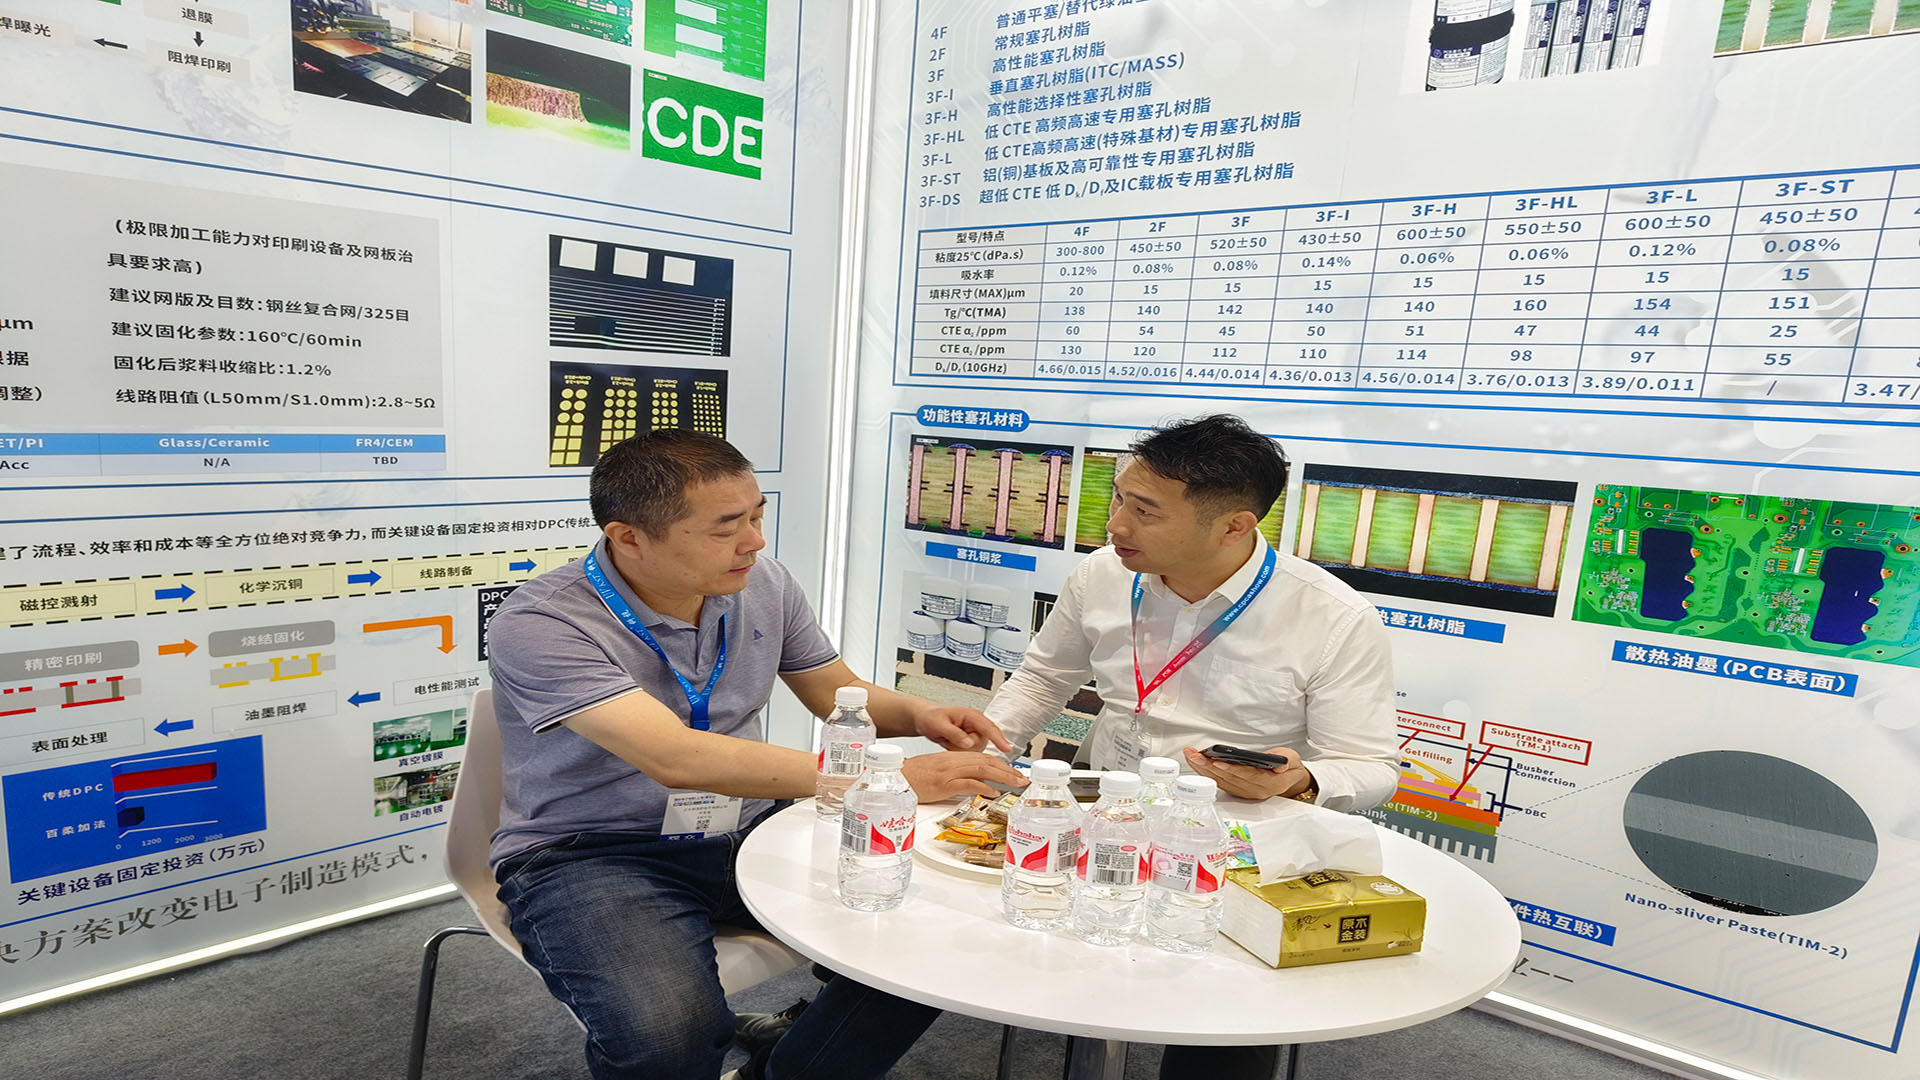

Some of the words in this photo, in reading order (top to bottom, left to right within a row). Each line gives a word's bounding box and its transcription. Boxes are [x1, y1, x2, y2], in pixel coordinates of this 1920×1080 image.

[181, 7, 213, 25] 退膜
[930, 26, 948, 40] 4F
[995, 20, 1091, 51] 常规塞孔树脂
[167, 50, 232, 74] 阻焊印刷
[929, 48, 946, 62] 2F
[992, 41, 1106, 74] 高性能塞孔树脂
[928, 69, 945, 83] 3F
[989, 51, 1185, 96] 垂直塞孔树脂(ITC/MASS)
[926, 89, 954, 104] 3F-I
[987, 80, 1152, 118] 高性能选择性塞孔树脂
[925, 109, 958, 125] 3F-H
[985, 125, 998, 140] 低
[1003, 122, 1031, 136] CTE
[1034, 97, 1211, 134] 高频高速专用塞孔树脂
[923, 130, 965, 146] 3F-HL
[922, 153, 953, 167] 3F-L
[985, 147, 998, 161] 低
[983, 141, 1255, 183] 铝(铜)基板及高可靠性专用塞孔树脂
[920, 172, 961, 188] 3F-ST
[979, 188, 1008, 204] 超低
[1012, 187, 1041, 200] CTE
[1046, 184, 1060, 199] 低
[1775, 179, 1855, 197] 3F-ST
[919, 193, 961, 208] 3F-DS
[1515, 196, 1578, 211] 3F-HL
[1645, 189, 1698, 204] 3F-L
[1315, 209, 1350, 223] 3F-I
[1411, 203, 1457, 217] 3F-H
[1759, 207, 1858, 225] 450±50
[1149, 222, 1166, 233] 2F
[1231, 216, 1251, 228] 3F
[1504, 221, 1582, 236] 550±50
[1624, 214, 1711, 232] 600±50
[956, 231, 1005, 243] 型号/特点
[1074, 226, 1090, 237] 4F
[1396, 226, 1466, 241] 600±50
[115, 218, 414, 264] (极限加工能力对印刷设备及网板治
[1209, 237, 1268, 251] 520±50
[1298, 232, 1362, 246] 430±50
[1764, 238, 1841, 254] 0.08%
[1056, 245, 1105, 257] 300-800
[1129, 241, 1182, 253] 450±50
[1508, 247, 1569, 261] 0.06%
[1628, 243, 1697, 258] 0.12%
[107, 252, 203, 275] 具要求高)
[1301, 256, 1352, 269] 0.14%
[1399, 252, 1455, 265] 0.06%
[1059, 265, 1098, 277] 0.12%
[1132, 263, 1174, 275] 0.08%
[1213, 260, 1258, 272] 0.08%
[961, 269, 995, 281] 吸水率
[1523, 274, 1545, 286] 15
[1645, 271, 1669, 284] 15
[1781, 267, 1810, 281] 15
[1143, 284, 1158, 295] 15
[1225, 283, 1242, 294] 15
[1313, 280, 1333, 291] 15
[1412, 277, 1434, 289] 15
[929, 288, 1026, 300] 填料尺寸(MAX)μm
[1069, 285, 1084, 297] 20
[109, 287, 410, 322] 建议网版及目数:钢丝复合网/325目
[1217, 304, 1243, 316] 142
[1305, 303, 1334, 314] 140
[1403, 301, 1435, 313] 140
[1512, 299, 1547, 312] 160
[1633, 298, 1672, 311] 154
[1768, 296, 1811, 310] 151
[1064, 305, 1086, 317] 138
[1137, 305, 1161, 316] 140
[112, 321, 362, 349] 建议固化参数:160°C/60min
[941, 326, 961, 336] CTE
[1065, 325, 1081, 336] 60
[1138, 325, 1155, 336] 54
[1219, 325, 1236, 336] 45
[1306, 325, 1326, 337] 50
[1405, 325, 1425, 337] 51
[1514, 325, 1537, 337] 47
[1634, 325, 1660, 338] 44
[1768, 324, 1798, 338] 25
[940, 344, 960, 354] CTE
[1060, 345, 1082, 356] 130
[1133, 346, 1157, 357] 120
[1213, 346, 1239, 358] 112
[1299, 348, 1327, 360] 110
[1396, 349, 1428, 361] 114
[1510, 350, 1532, 363] 98
[1629, 350, 1655, 364] 97
[1763, 353, 1792, 366] 55
[113, 355, 332, 377] 固化后浆料收缩比:1.2%
[1038, 363, 1101, 376] 4.66/0.015
[1108, 365, 1178, 378] 4.52/0.016
[1185, 366, 1260, 380] 4.44/0.014
[1269, 369, 1353, 384] 4.36/0.013
[1362, 372, 1456, 387] 4.56/0.014
[1467, 374, 1570, 389] 3.76/0.013
[1582, 376, 1695, 392] 3.89/0.011
[115, 389, 436, 410] 线路阻值(L50mm/S1.0mm):2.8~5Ω
[923, 408, 1023, 428] 功能性塞孔材料
[159, 437, 270, 449] Glass/Ceramic
[355, 437, 413, 448] FR4/CEM
[0, 460, 29, 470] Acc
[203, 457, 230, 468] N/A
[373, 455, 398, 466] TBD
[0, 517, 599, 560] 了流程、效率和成本等全方位绝对竞争力，而关键设备固定投资相对DPC传统
[957, 548, 1002, 565] 塞孔铜浆
[419, 566, 474, 580] 线路制备
[239, 578, 303, 594] 化学沉铜
[1222, 565, 1270, 622] www.cpcashow.com
[20, 594, 98, 611] 磁控溅射
[240, 630, 305, 647] 烧结固化
[24, 651, 102, 672] 精密印刷
[1625, 645, 1845, 693] 散热油墨(PCB表面)
[414, 677, 480, 696] 电性能测试
[245, 702, 307, 721] 油墨阻焊
[31, 731, 108, 753] 表面处理
[1491, 727, 1543, 744] Substrate
[1545, 739, 1581, 751] attach
[1516, 739, 1552, 753] (TM-1)
[398, 751, 444, 768] 真空镀膜
[1405, 747, 1421, 757] Gel
[1423, 751, 1453, 765] filling
[1516, 762, 1555, 777] Busber
[1515, 770, 1576, 788] connection
[42, 783, 104, 802] 传统DPC
[400, 804, 444, 822] 自动电镀
[1525, 808, 1547, 819] DBC
[45, 820, 106, 839] 百柔加法
[17, 838, 265, 905] 关键设备固定投资(万元)
[1342, 917, 1368, 929] 原木
[1625, 892, 1724, 925] Nano-sliver
[1728, 919, 1849, 960] Paste(TIM-2)
[1341, 930, 1367, 942] 金装
